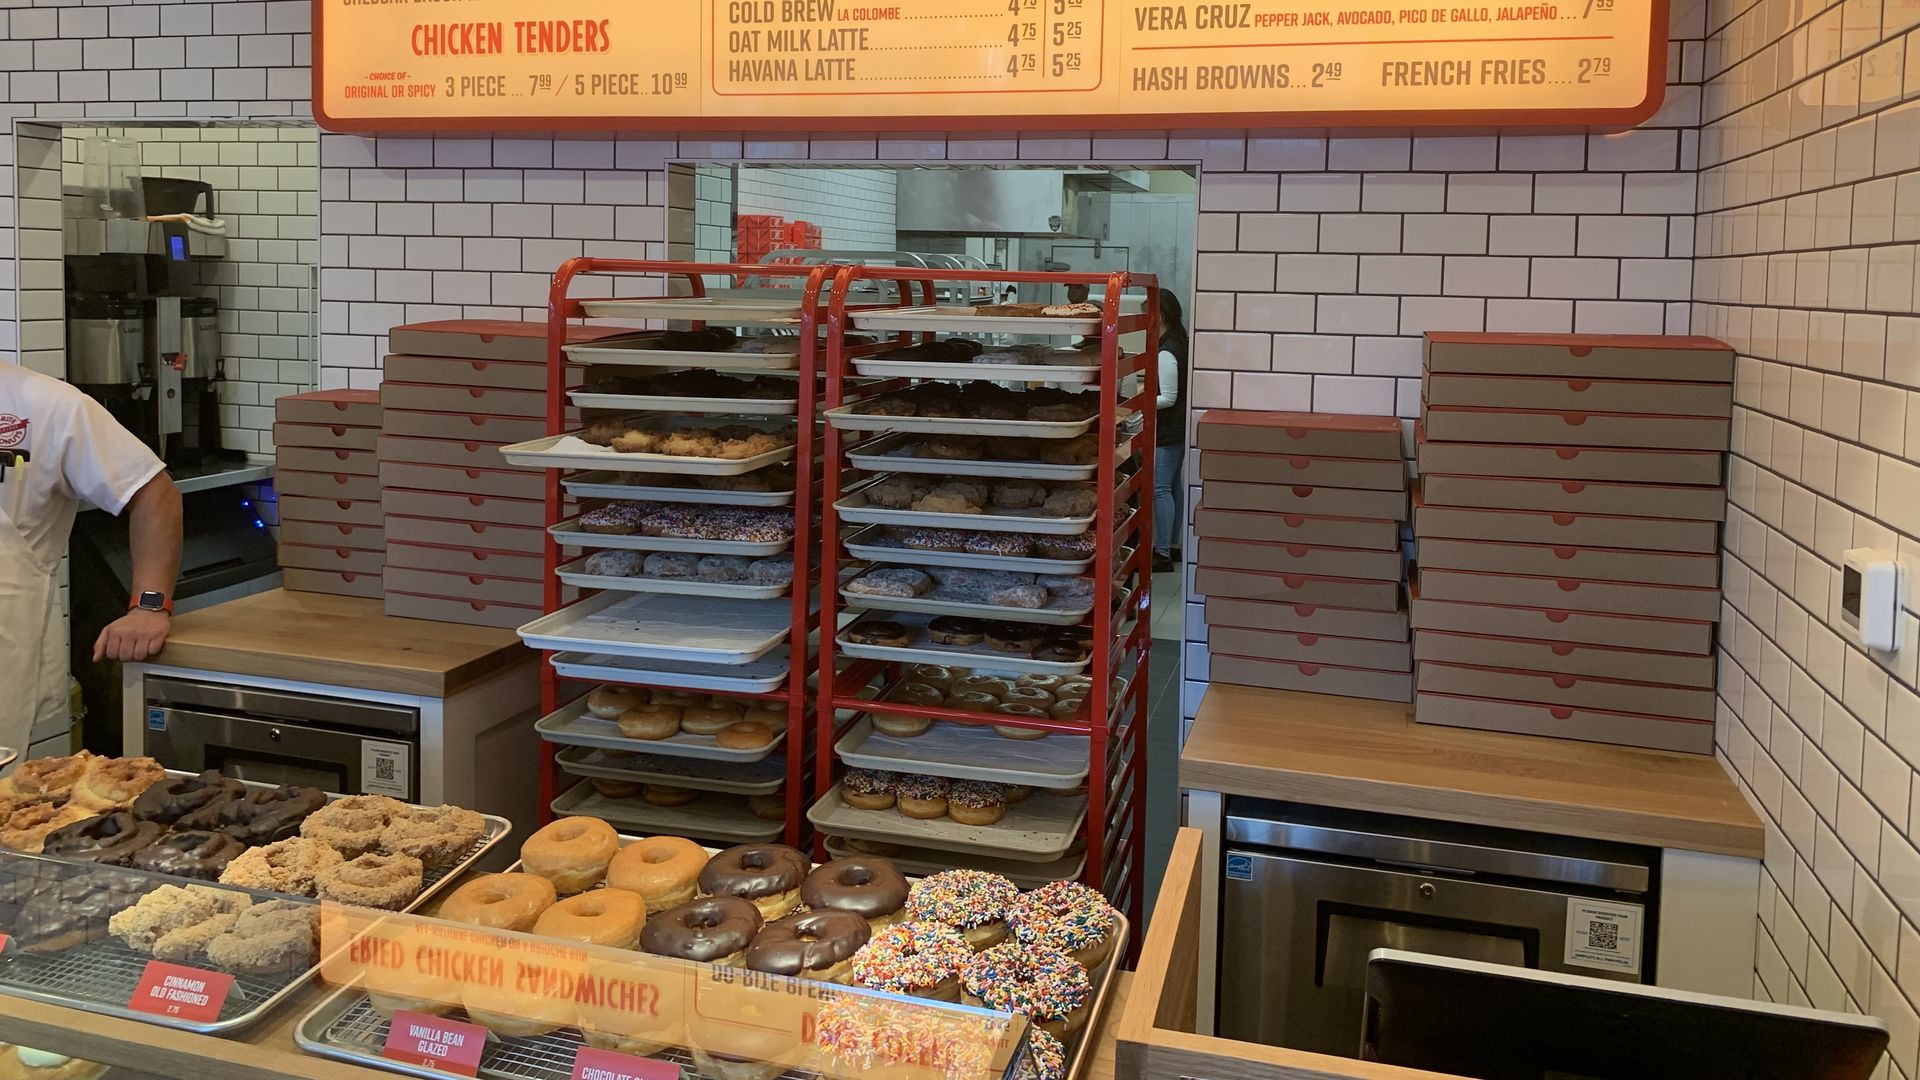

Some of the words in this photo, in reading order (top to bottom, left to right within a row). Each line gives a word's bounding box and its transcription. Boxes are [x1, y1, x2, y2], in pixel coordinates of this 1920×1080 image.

[728, 0, 775, 24] COLD
[781, 0, 835, 23] BREW
[837, 8, 850, 22] LA
[852, 7, 901, 21] COLOMBE
[1134, 6, 1188, 31] VERA
[1195, 3, 1251, 30] CRUZ
[1254, 13, 1299, 28] PEPPER
[1301, 12, 1334, 28] JACK,
[1336, 10, 1396, 26] AVOCADO,
[1399, 8, 1428, 24] PICO
[1431, 9, 1447, 23] DE
[1450, 7, 1493, 24] GALLO,
[1495, 3, 1558, 22] JALAPEÑO
[411, 22, 503, 57] CHICKEN
[514, 18, 611, 54] TENDERS
[728, 30, 761, 53] OAT
[767, 28, 812, 53] MILK
[817, 27, 869, 51] LATTE
[728, 58, 798, 82] HAVANA
[804, 57, 856, 81] LATTE
[1132, 65, 1188, 92] HASH
[1195, 63, 1290, 91] BROWNS
[1381, 59, 1471, 87] FRENCH
[1480, 58, 1547, 85] FRIES
[344, 85, 388, 99] ORIGINAL
[391, 84, 405, 98] OR
[407, 84, 436, 98] SPICY
[445, 76, 455, 98] 3
[460, 75, 506, 97] PIECE
[575, 74, 585, 96] 5
[591, 73, 640, 96] PIECE
[149, 985, 167, 999] OLD
[166, 989, 210, 1007] FASHIONED
[163, 975, 207, 993] CINNAMON
[409, 1024, 441, 1043] VANILLA
[442, 1031, 465, 1047] BEAN
[417, 1040, 449, 1057] GLAZED
